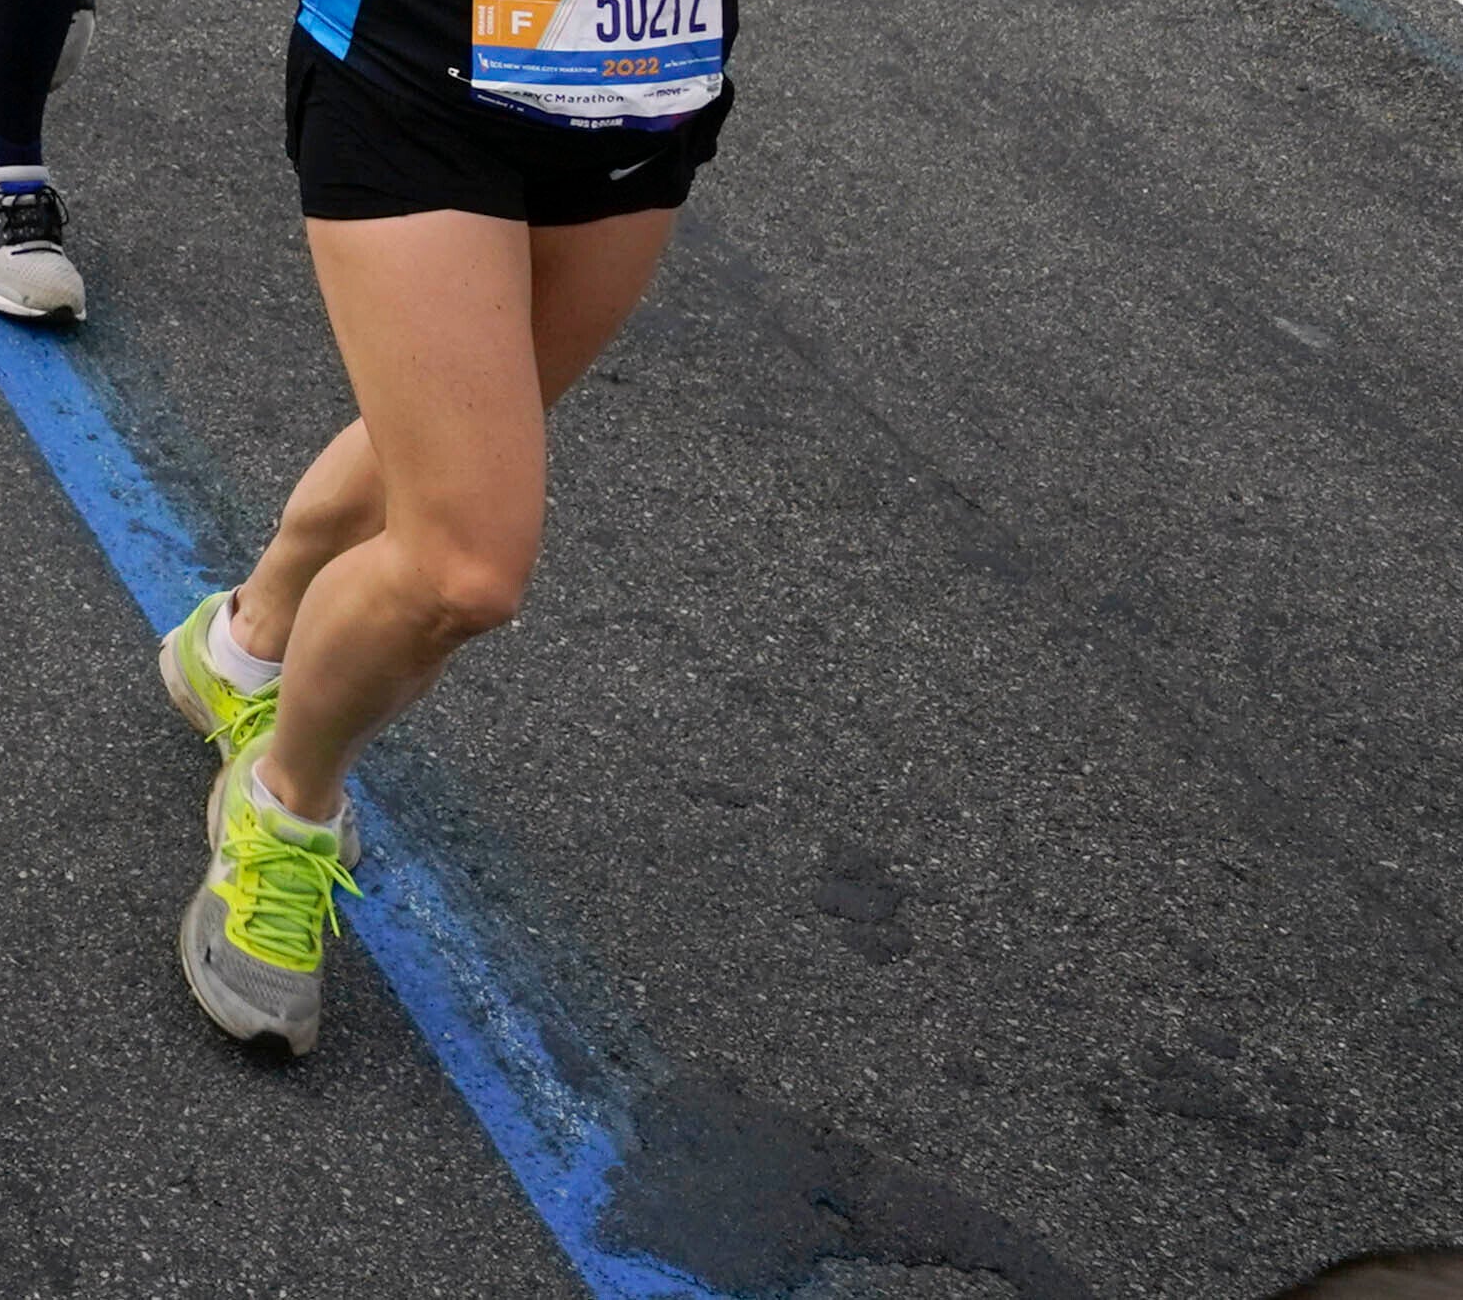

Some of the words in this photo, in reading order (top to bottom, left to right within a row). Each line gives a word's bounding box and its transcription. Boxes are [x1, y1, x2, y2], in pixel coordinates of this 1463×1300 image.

[511, 10, 534, 35] F
[600, 56, 661, 78] 2022
[655, 85, 684, 98] move
